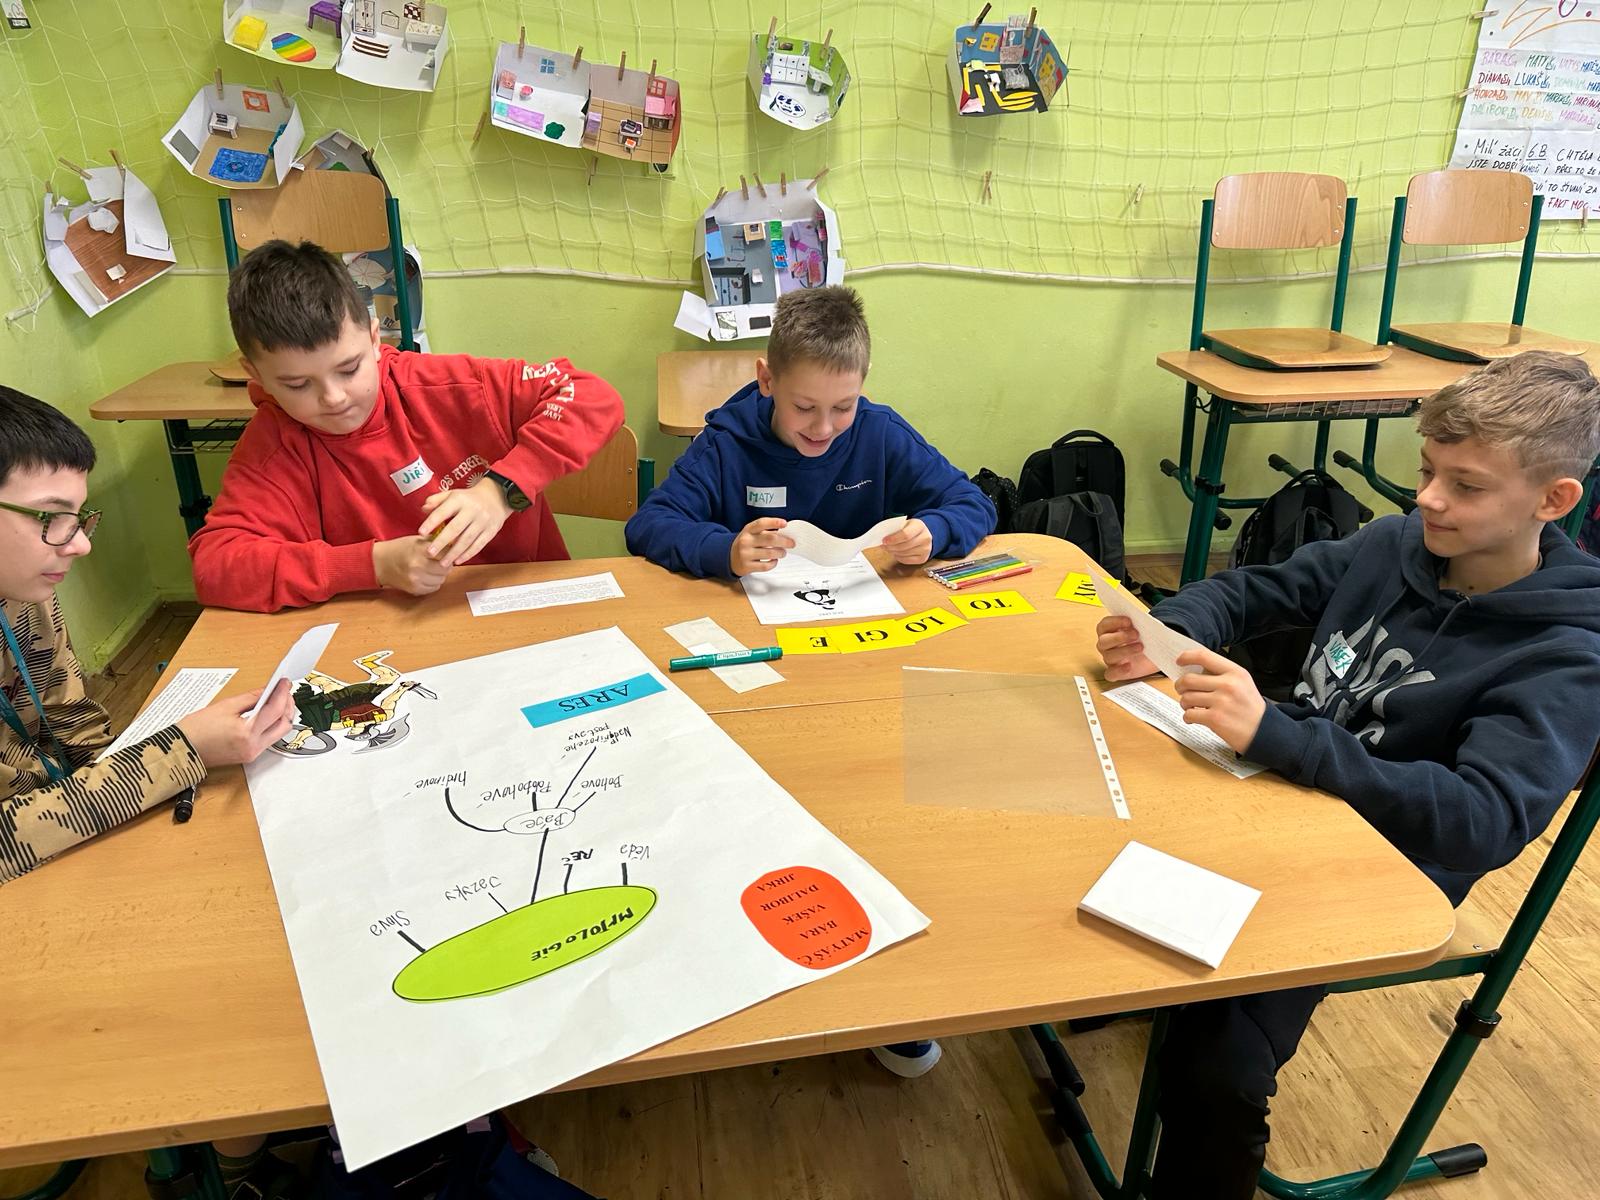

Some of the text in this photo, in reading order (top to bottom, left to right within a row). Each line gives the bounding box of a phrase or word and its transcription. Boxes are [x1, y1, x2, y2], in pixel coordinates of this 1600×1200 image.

[835, 479, 873, 492] Champion
[748, 491, 775, 505] MATY
[810, 597, 1013, 649] TO LO GI E
[558, 684, 630, 713] ARES
[619, 843, 650, 860] Věda
[445, 875, 502, 902] Jazyky
[756, 873, 795, 892] JIRKA
[760, 884, 819, 911] DALIBOR
[369, 909, 411, 938] Slova
[782, 904, 826, 925] VAŠEK
[799, 920, 838, 940] BÁRA
[813, 927, 869, 961] MATYÁŠ
